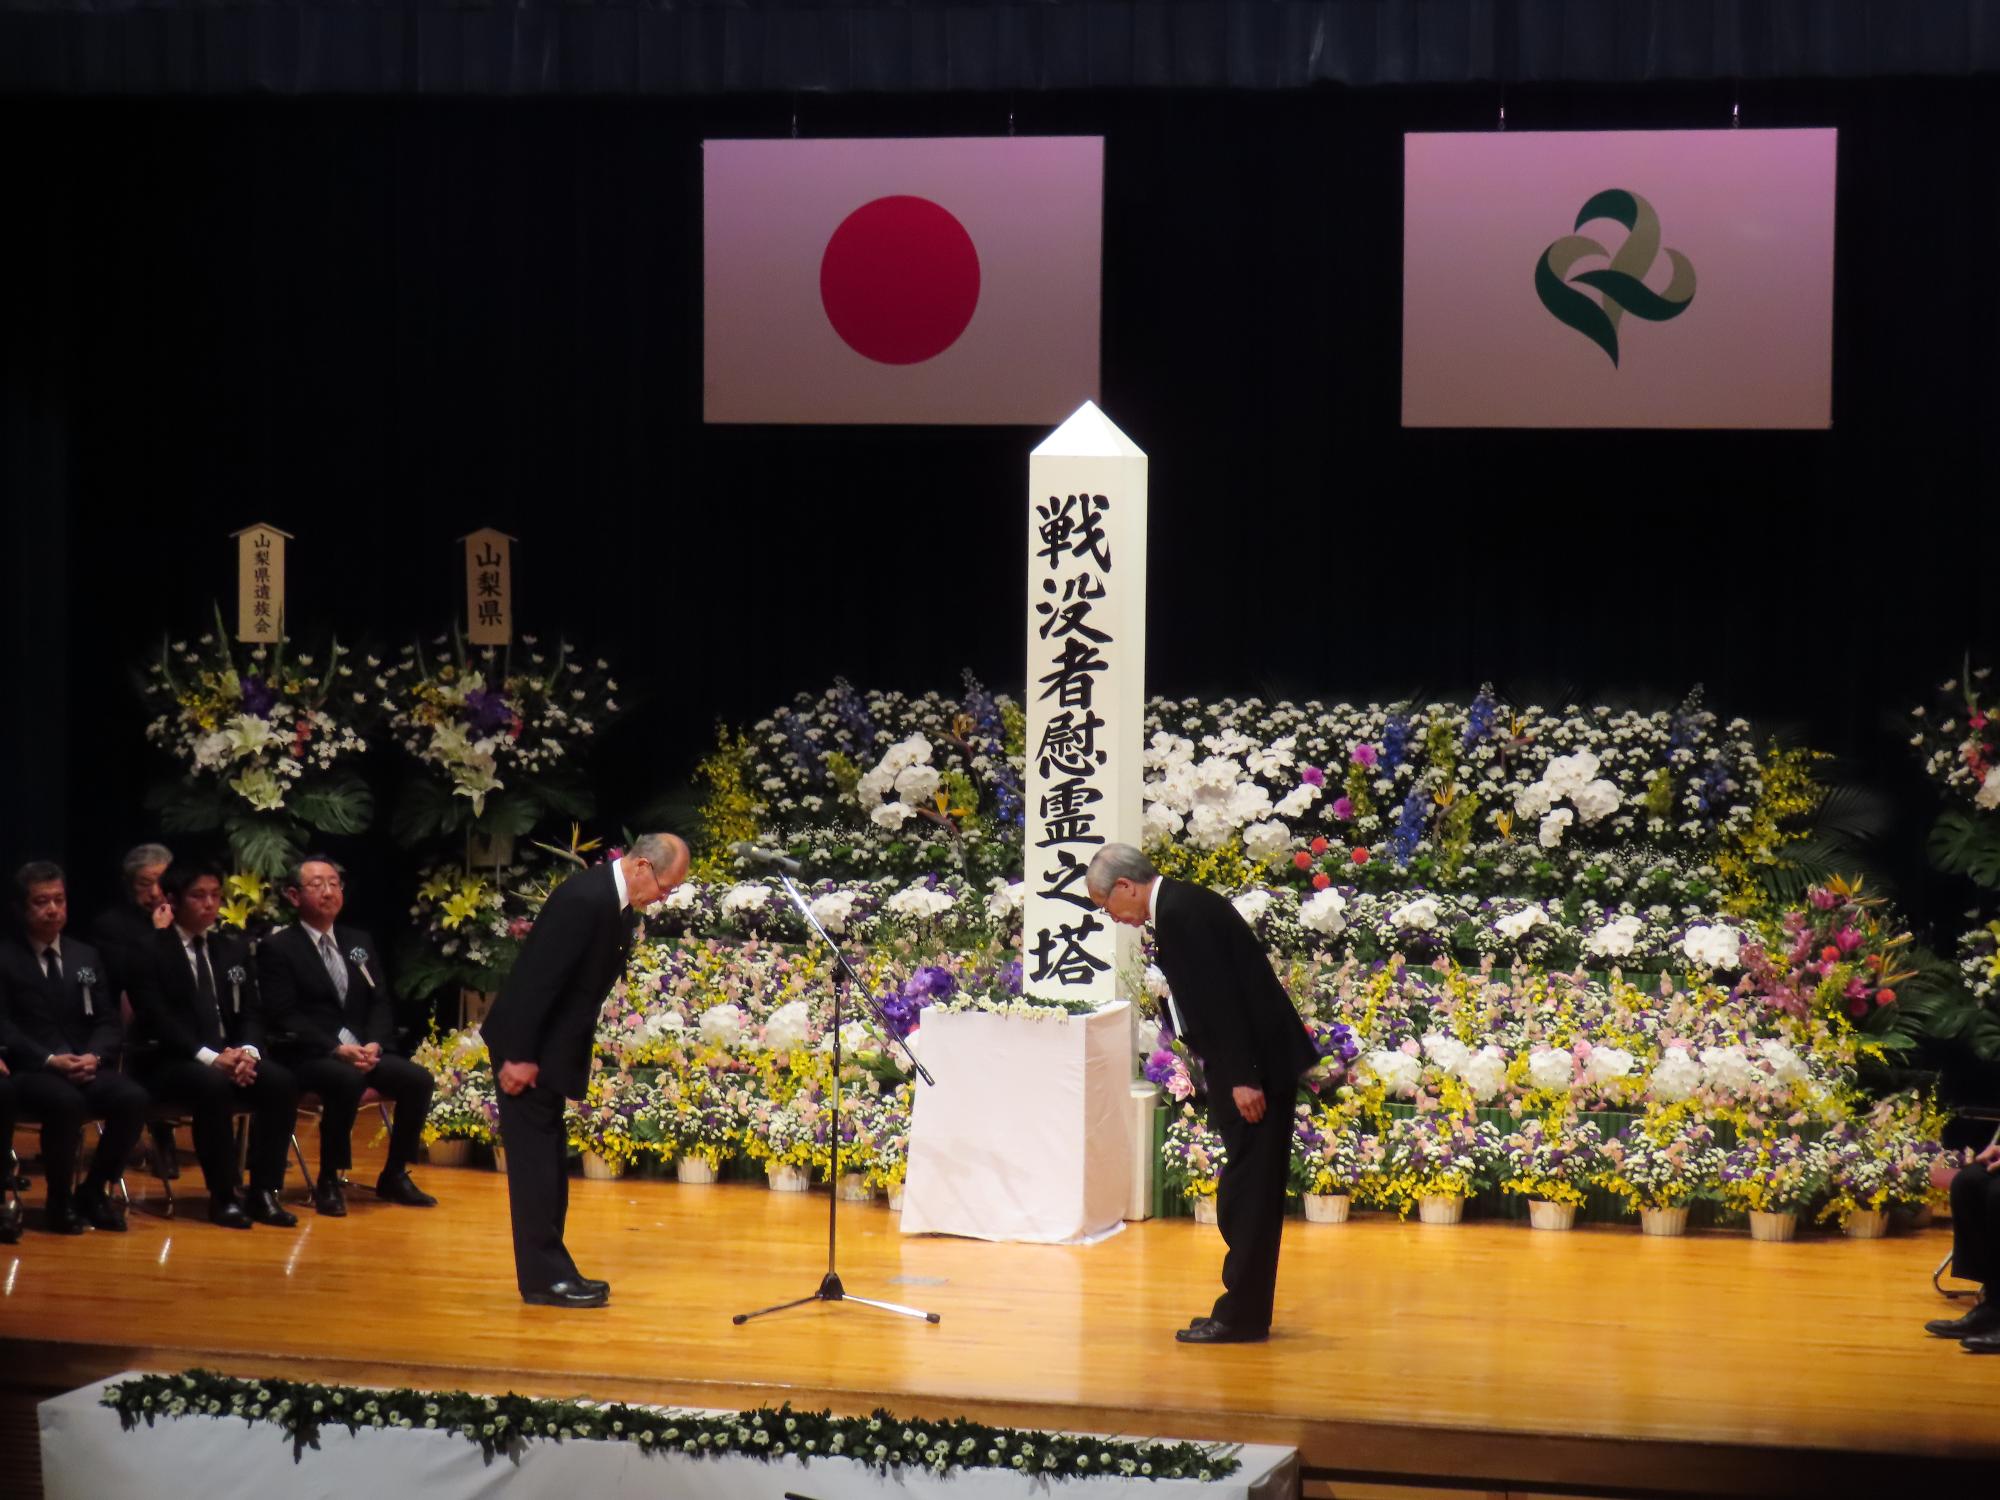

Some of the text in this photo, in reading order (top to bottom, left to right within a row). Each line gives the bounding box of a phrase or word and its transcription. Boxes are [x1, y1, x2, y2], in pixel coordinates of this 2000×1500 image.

[254, 533, 271, 634] 山梨県遺族会
[476, 541, 503, 626] 山梨県
[1028, 493, 1114, 986] 戦没者慰霊之塔
